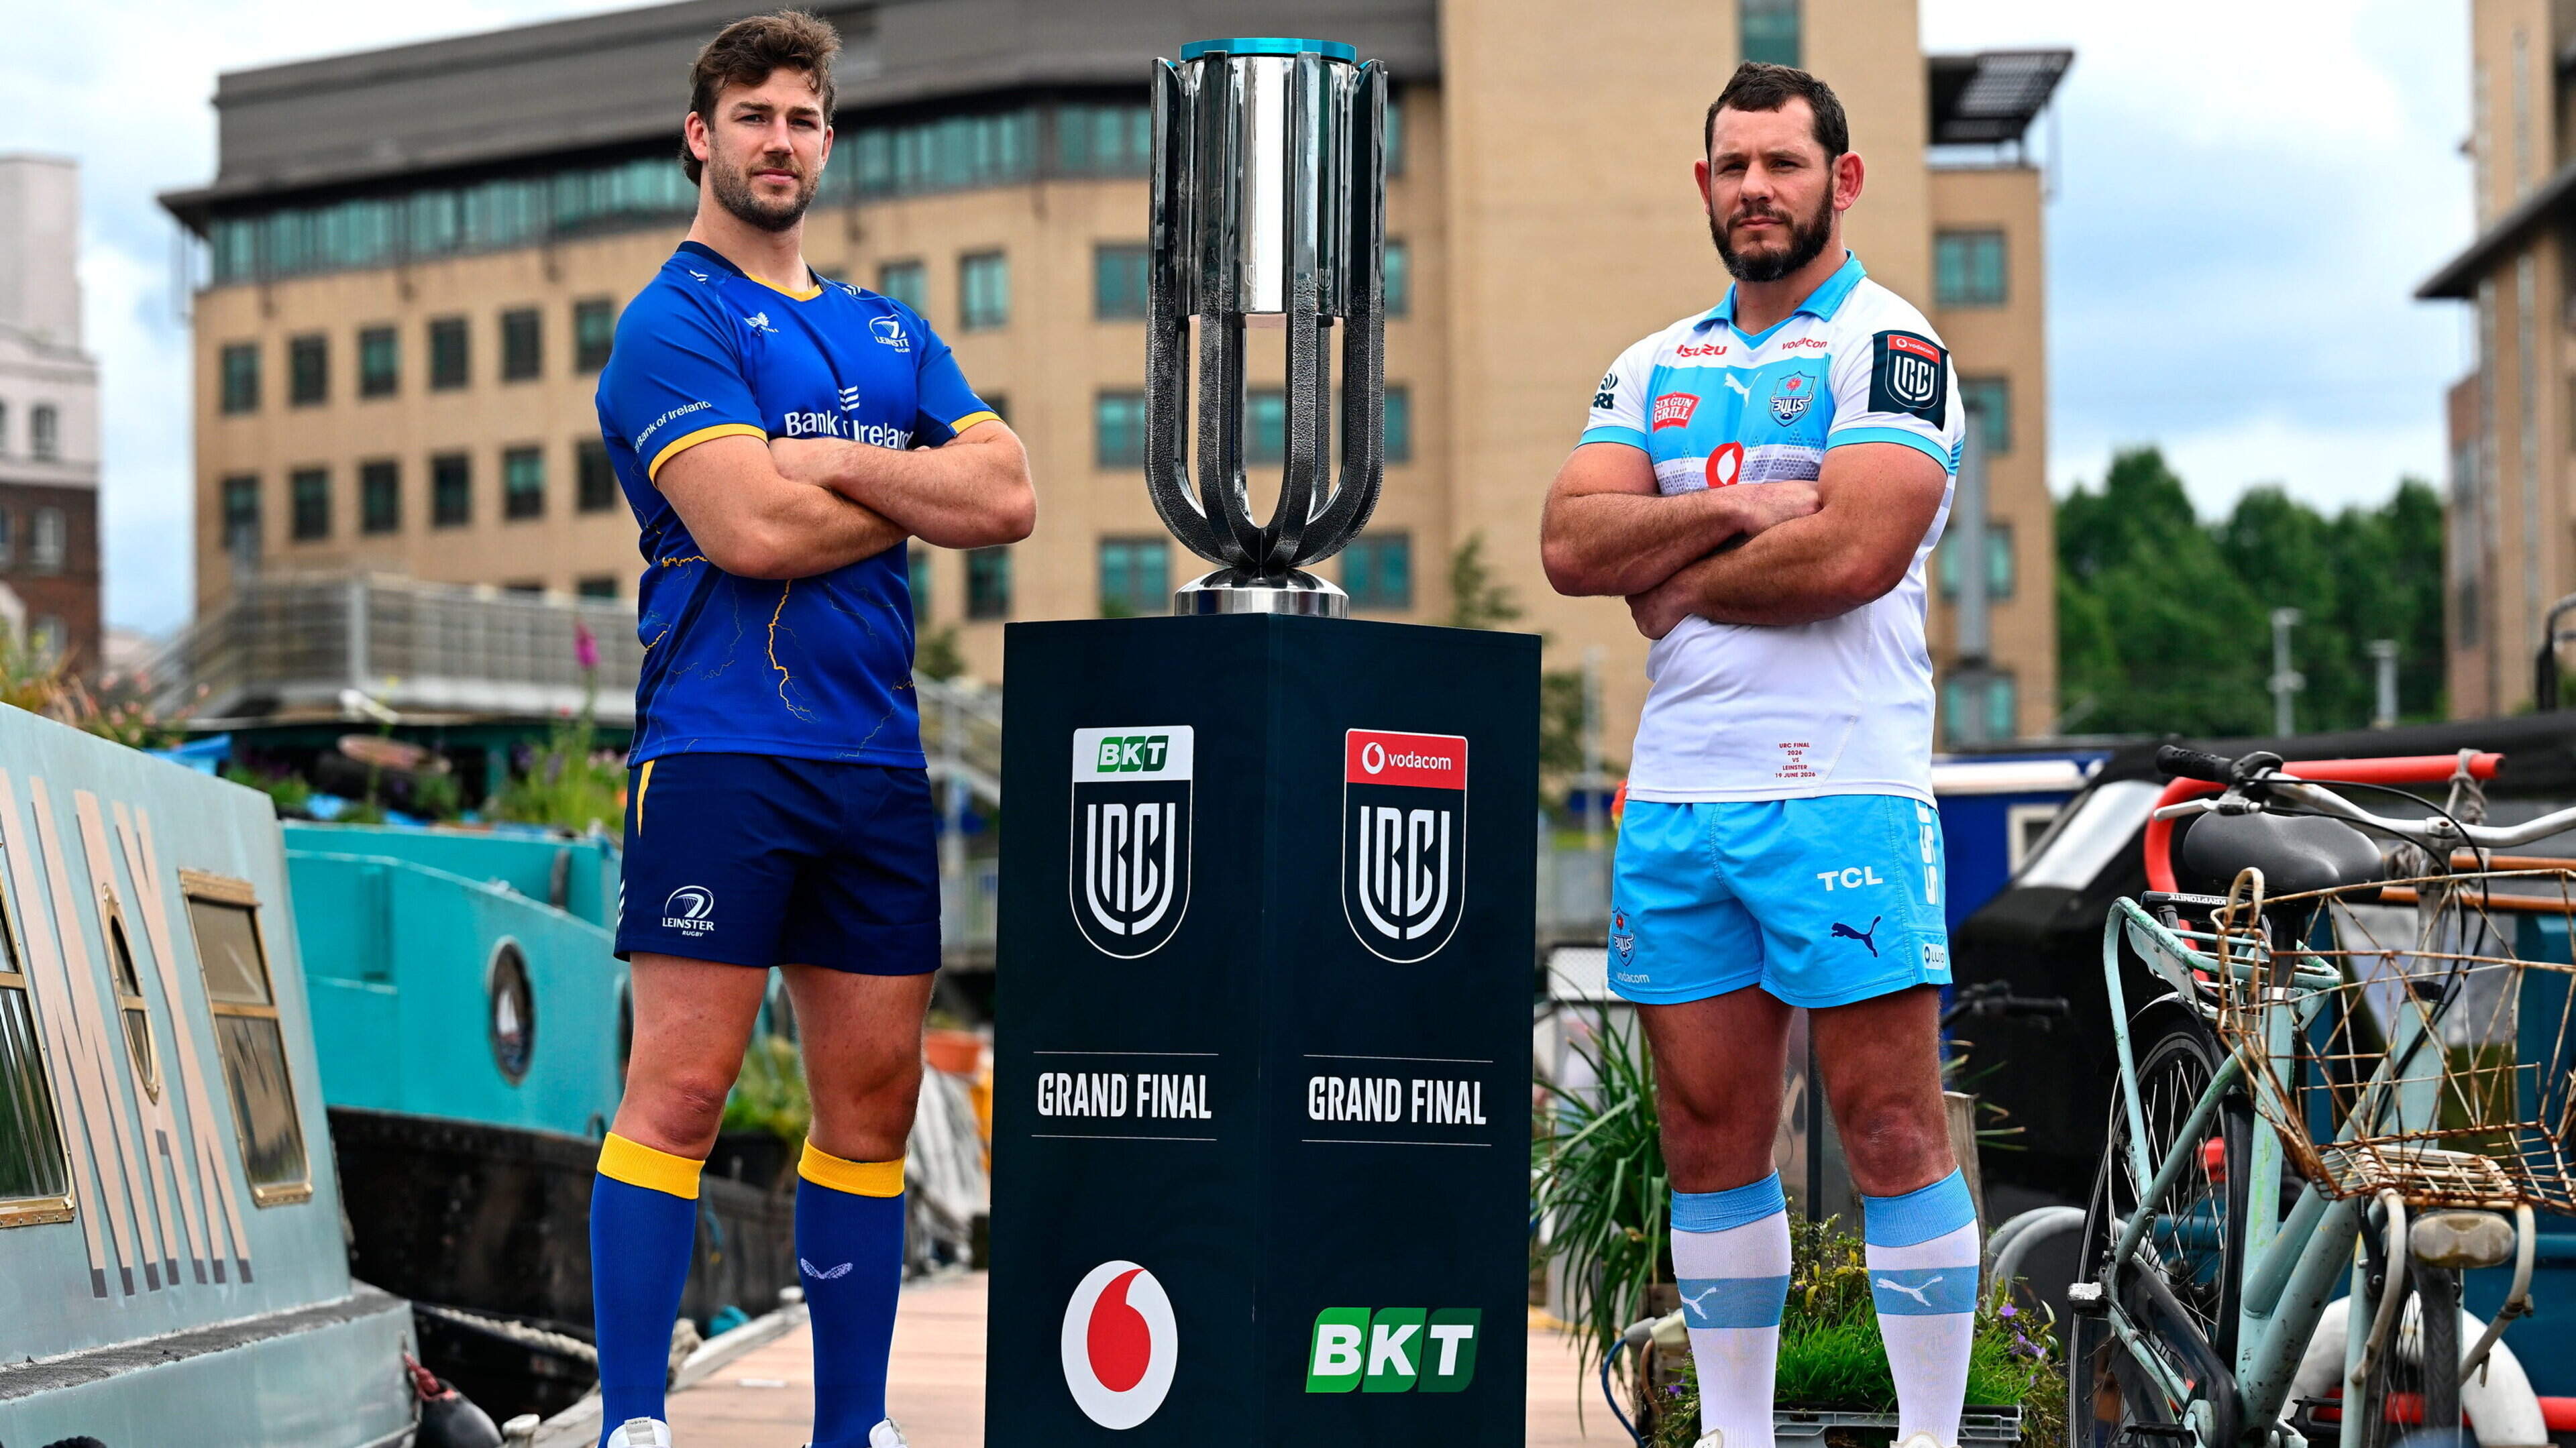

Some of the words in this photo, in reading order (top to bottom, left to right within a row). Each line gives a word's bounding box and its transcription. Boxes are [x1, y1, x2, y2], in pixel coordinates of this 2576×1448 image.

[1676, 344, 1727, 357] ISUZU
[1909, 343, 1935, 356] vodacom
[1894, 355, 1935, 401] URC
[1654, 400, 1671, 410] SIX
[1670, 397, 1695, 408] GUN
[1654, 406, 1689, 423] GRILL
[1773, 398, 1805, 412] BULLS
[637, 423, 657, 447] Bank
[656, 413, 667, 427] of
[784, 410, 839, 436] Bank
[1099, 742, 1167, 766] BKT
[1388, 751, 1452, 771] vodacom
[1086, 803, 1175, 935] URC
[1359, 805, 1450, 940] URC
[1817, 865, 1884, 891] TCL
[2167, 894, 2226, 905] KRYPTONITE
[662, 917, 714, 931] LEINSTER
[1037, 1073, 1127, 1117] GRAND
[1136, 1074, 1212, 1119] FINAL
[1308, 1076, 1401, 1122] GRAND
[1411, 1079, 1487, 1125] FINAL
[1312, 1324, 1474, 1376] BKT
